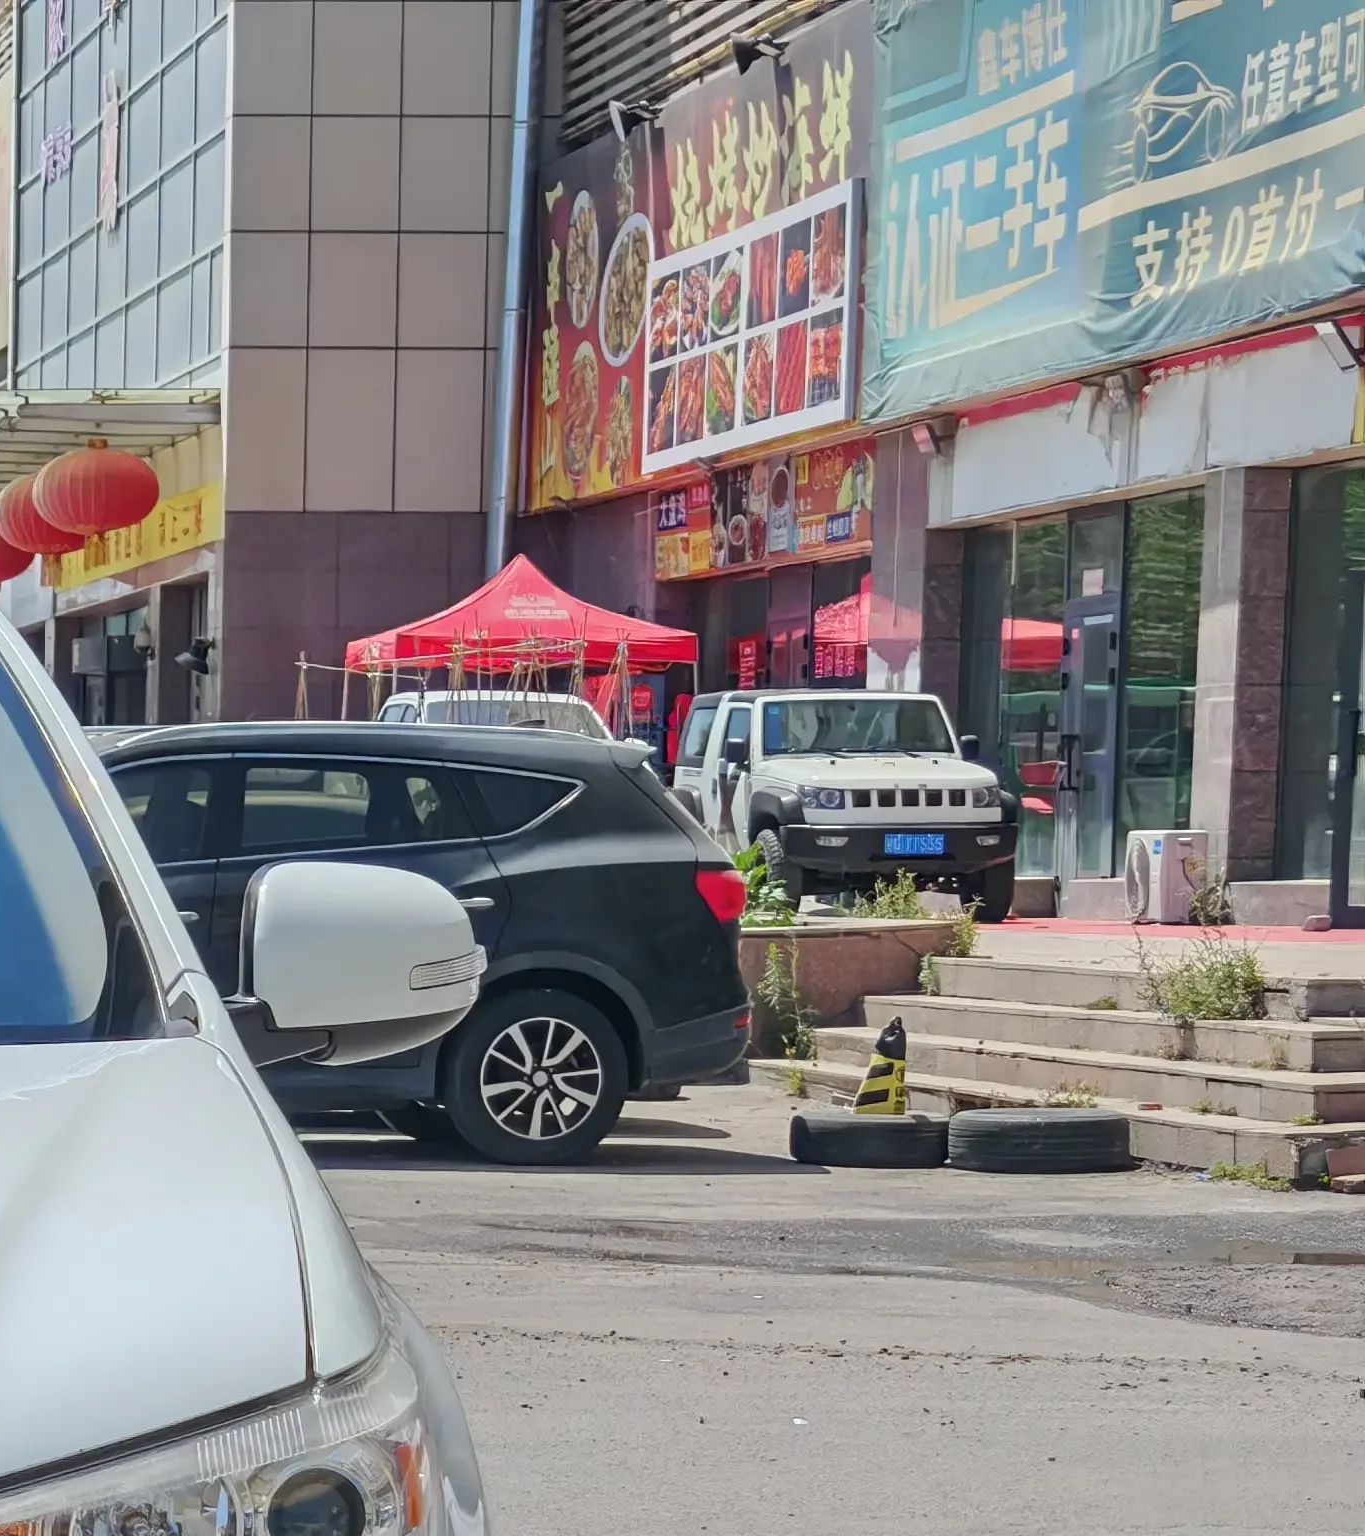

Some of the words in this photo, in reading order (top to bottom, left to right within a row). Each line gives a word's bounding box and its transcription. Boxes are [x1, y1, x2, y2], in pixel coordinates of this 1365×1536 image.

[885, 110, 1068, 339] 认证二手车
